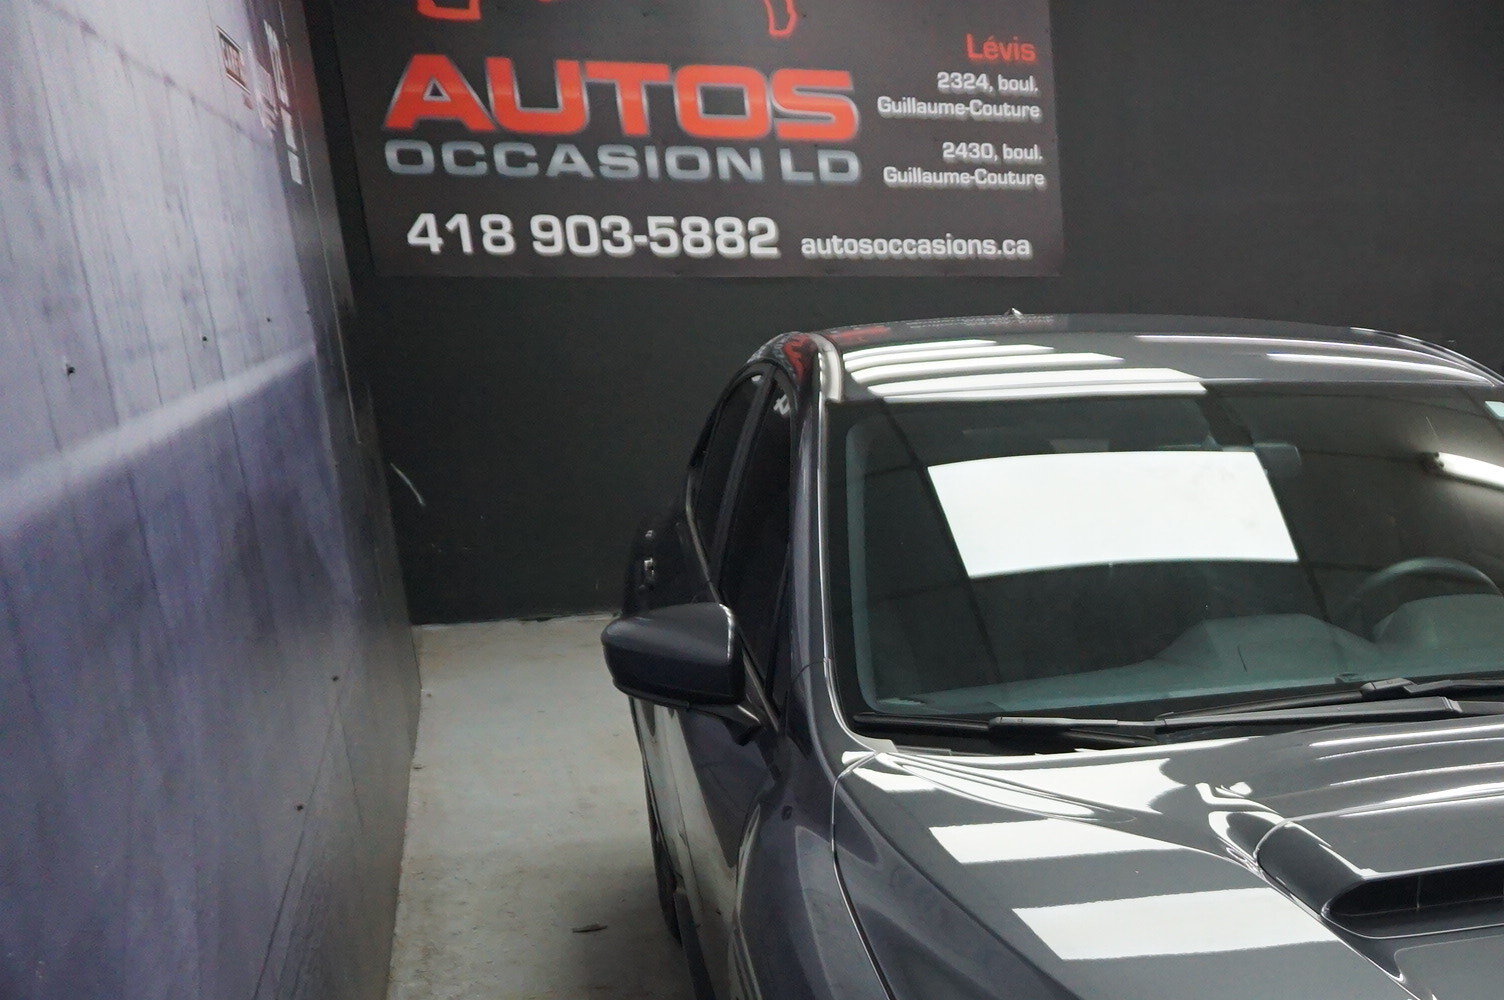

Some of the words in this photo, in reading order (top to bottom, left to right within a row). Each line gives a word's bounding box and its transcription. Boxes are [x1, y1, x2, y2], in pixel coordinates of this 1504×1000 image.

[966, 33, 1037, 62] Lévis
[937, 72, 994, 95] 2324,
[997, 74, 1039, 94] boul.
[383, 53, 859, 141] AUTOS
[877, 96, 1041, 119] Guillaume-Couture
[384, 139, 765, 181] OCCASION
[779, 147, 861, 183] LD
[942, 142, 998, 162] 2430,
[1002, 143, 1043, 162] boul.
[883, 166, 1046, 187] Guillaume-Couture
[406, 212, 514, 256] 418
[530, 214, 780, 258] 903-5882
[801, 233, 1031, 257] autosoccasions.ca
